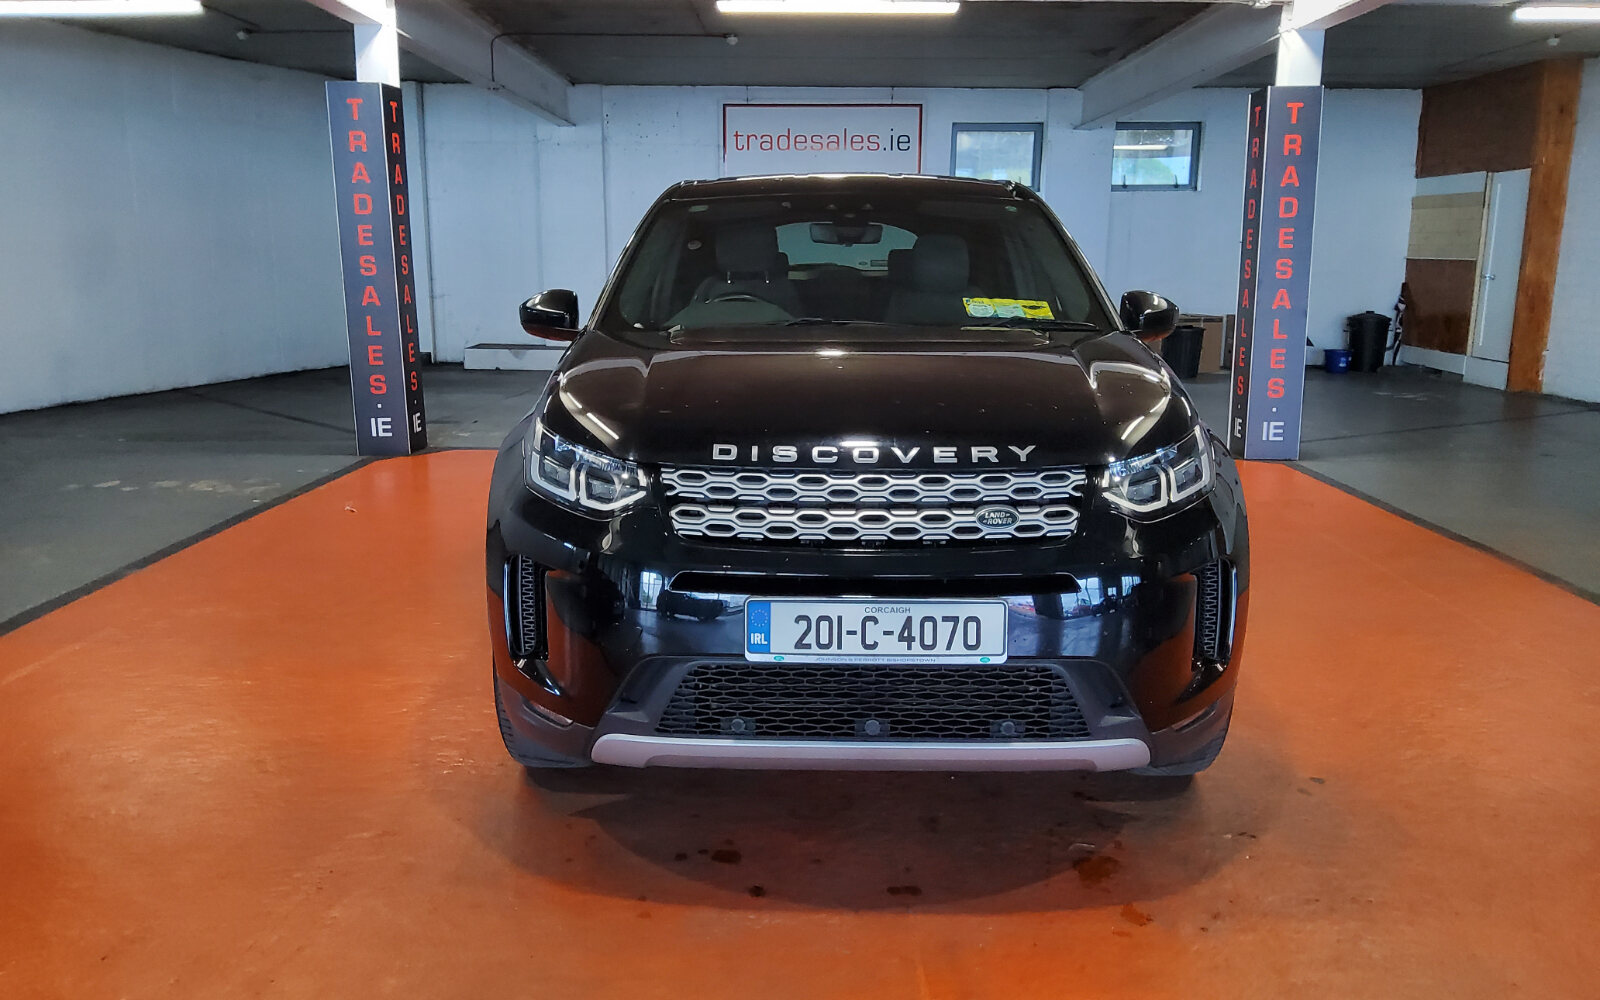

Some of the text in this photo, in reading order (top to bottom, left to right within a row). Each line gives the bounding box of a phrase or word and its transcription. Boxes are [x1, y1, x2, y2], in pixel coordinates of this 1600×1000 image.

[733, 127, 911, 152] tradesales.ie
[346, 98, 393, 437] TRADESALES.IE
[1261, 102, 1305, 441] TRADESALES.IE
[712, 443, 1036, 464] DISCOVERY
[987, 517, 1012, 525] ROVER
[864, 606, 911, 614] CORCAIGH
[750, 633, 768, 645] IRL
[794, 615, 981, 650] 201-C-4070
